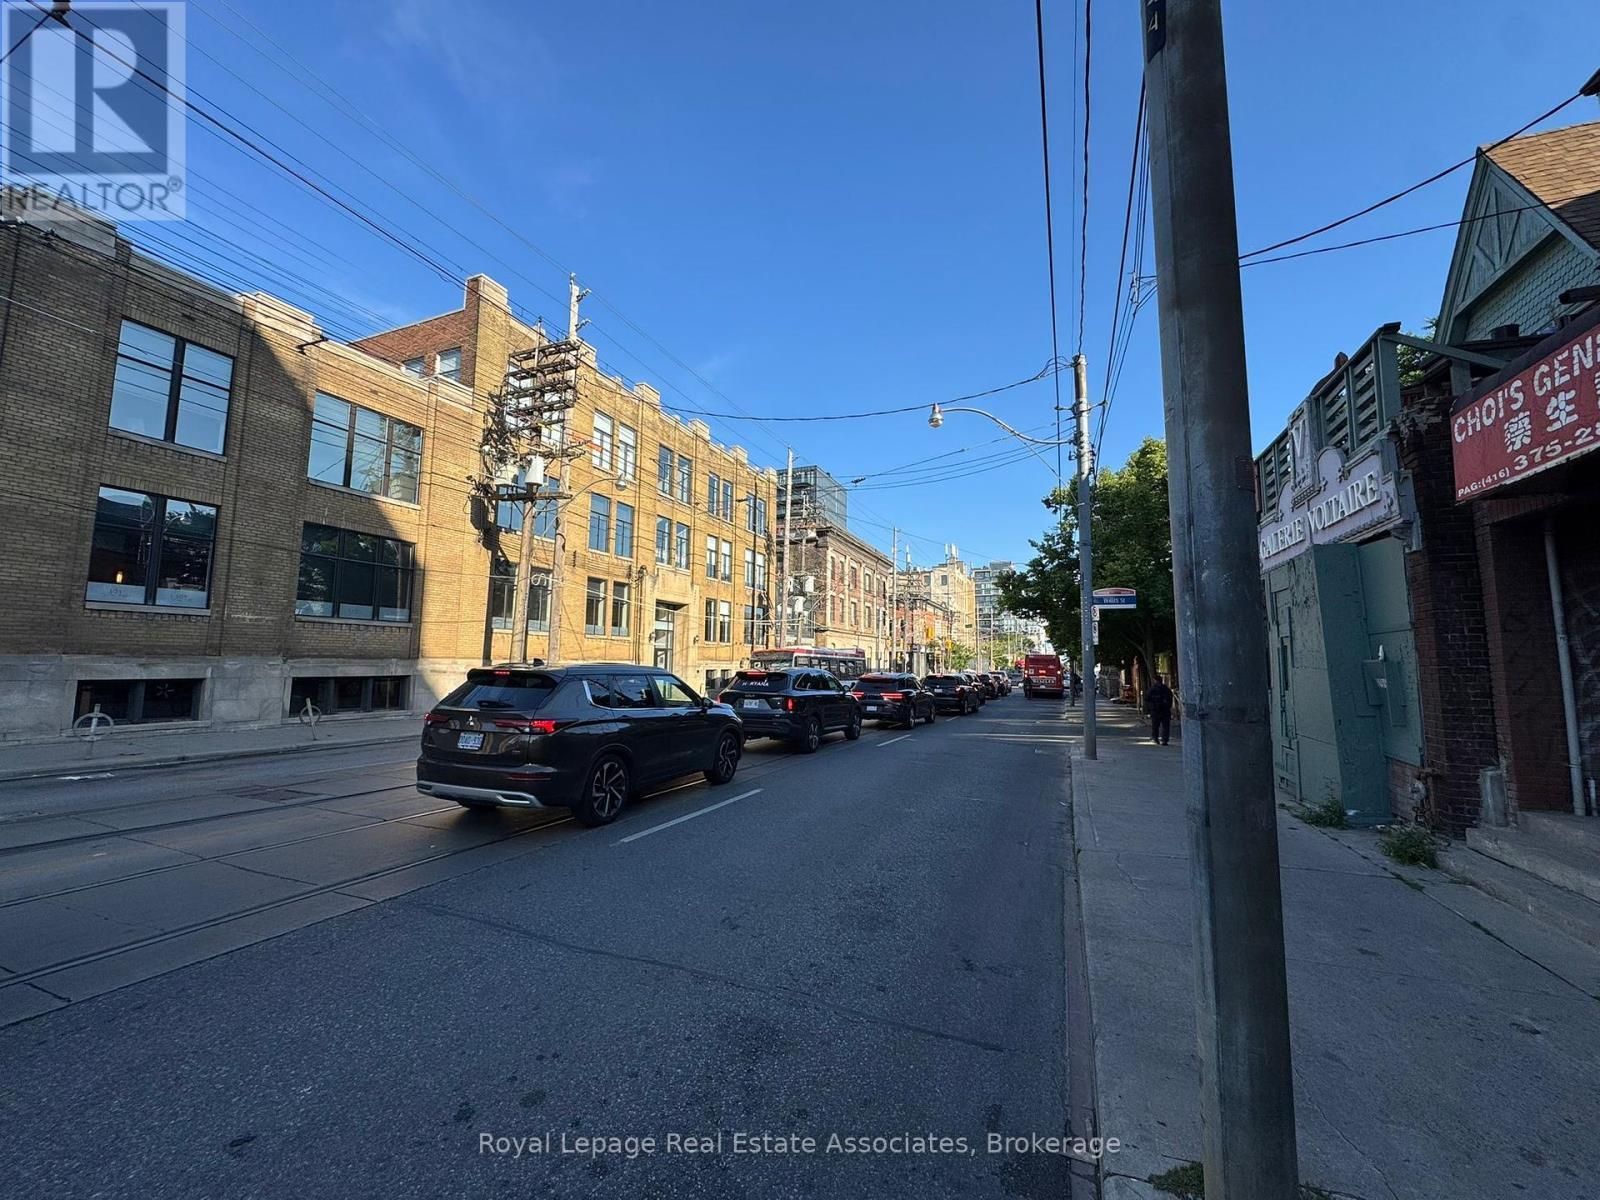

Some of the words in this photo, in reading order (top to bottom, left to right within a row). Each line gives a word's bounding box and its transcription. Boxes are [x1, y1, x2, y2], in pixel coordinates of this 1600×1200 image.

[1454, 379, 1525, 443] CHOI'S
[1533, 334, 1600, 396] GEN
[1513, 421, 1600, 471] 375-2
[1260, 516, 1306, 560] GALERIE
[1307, 471, 1380, 534] VOLTAIRE
